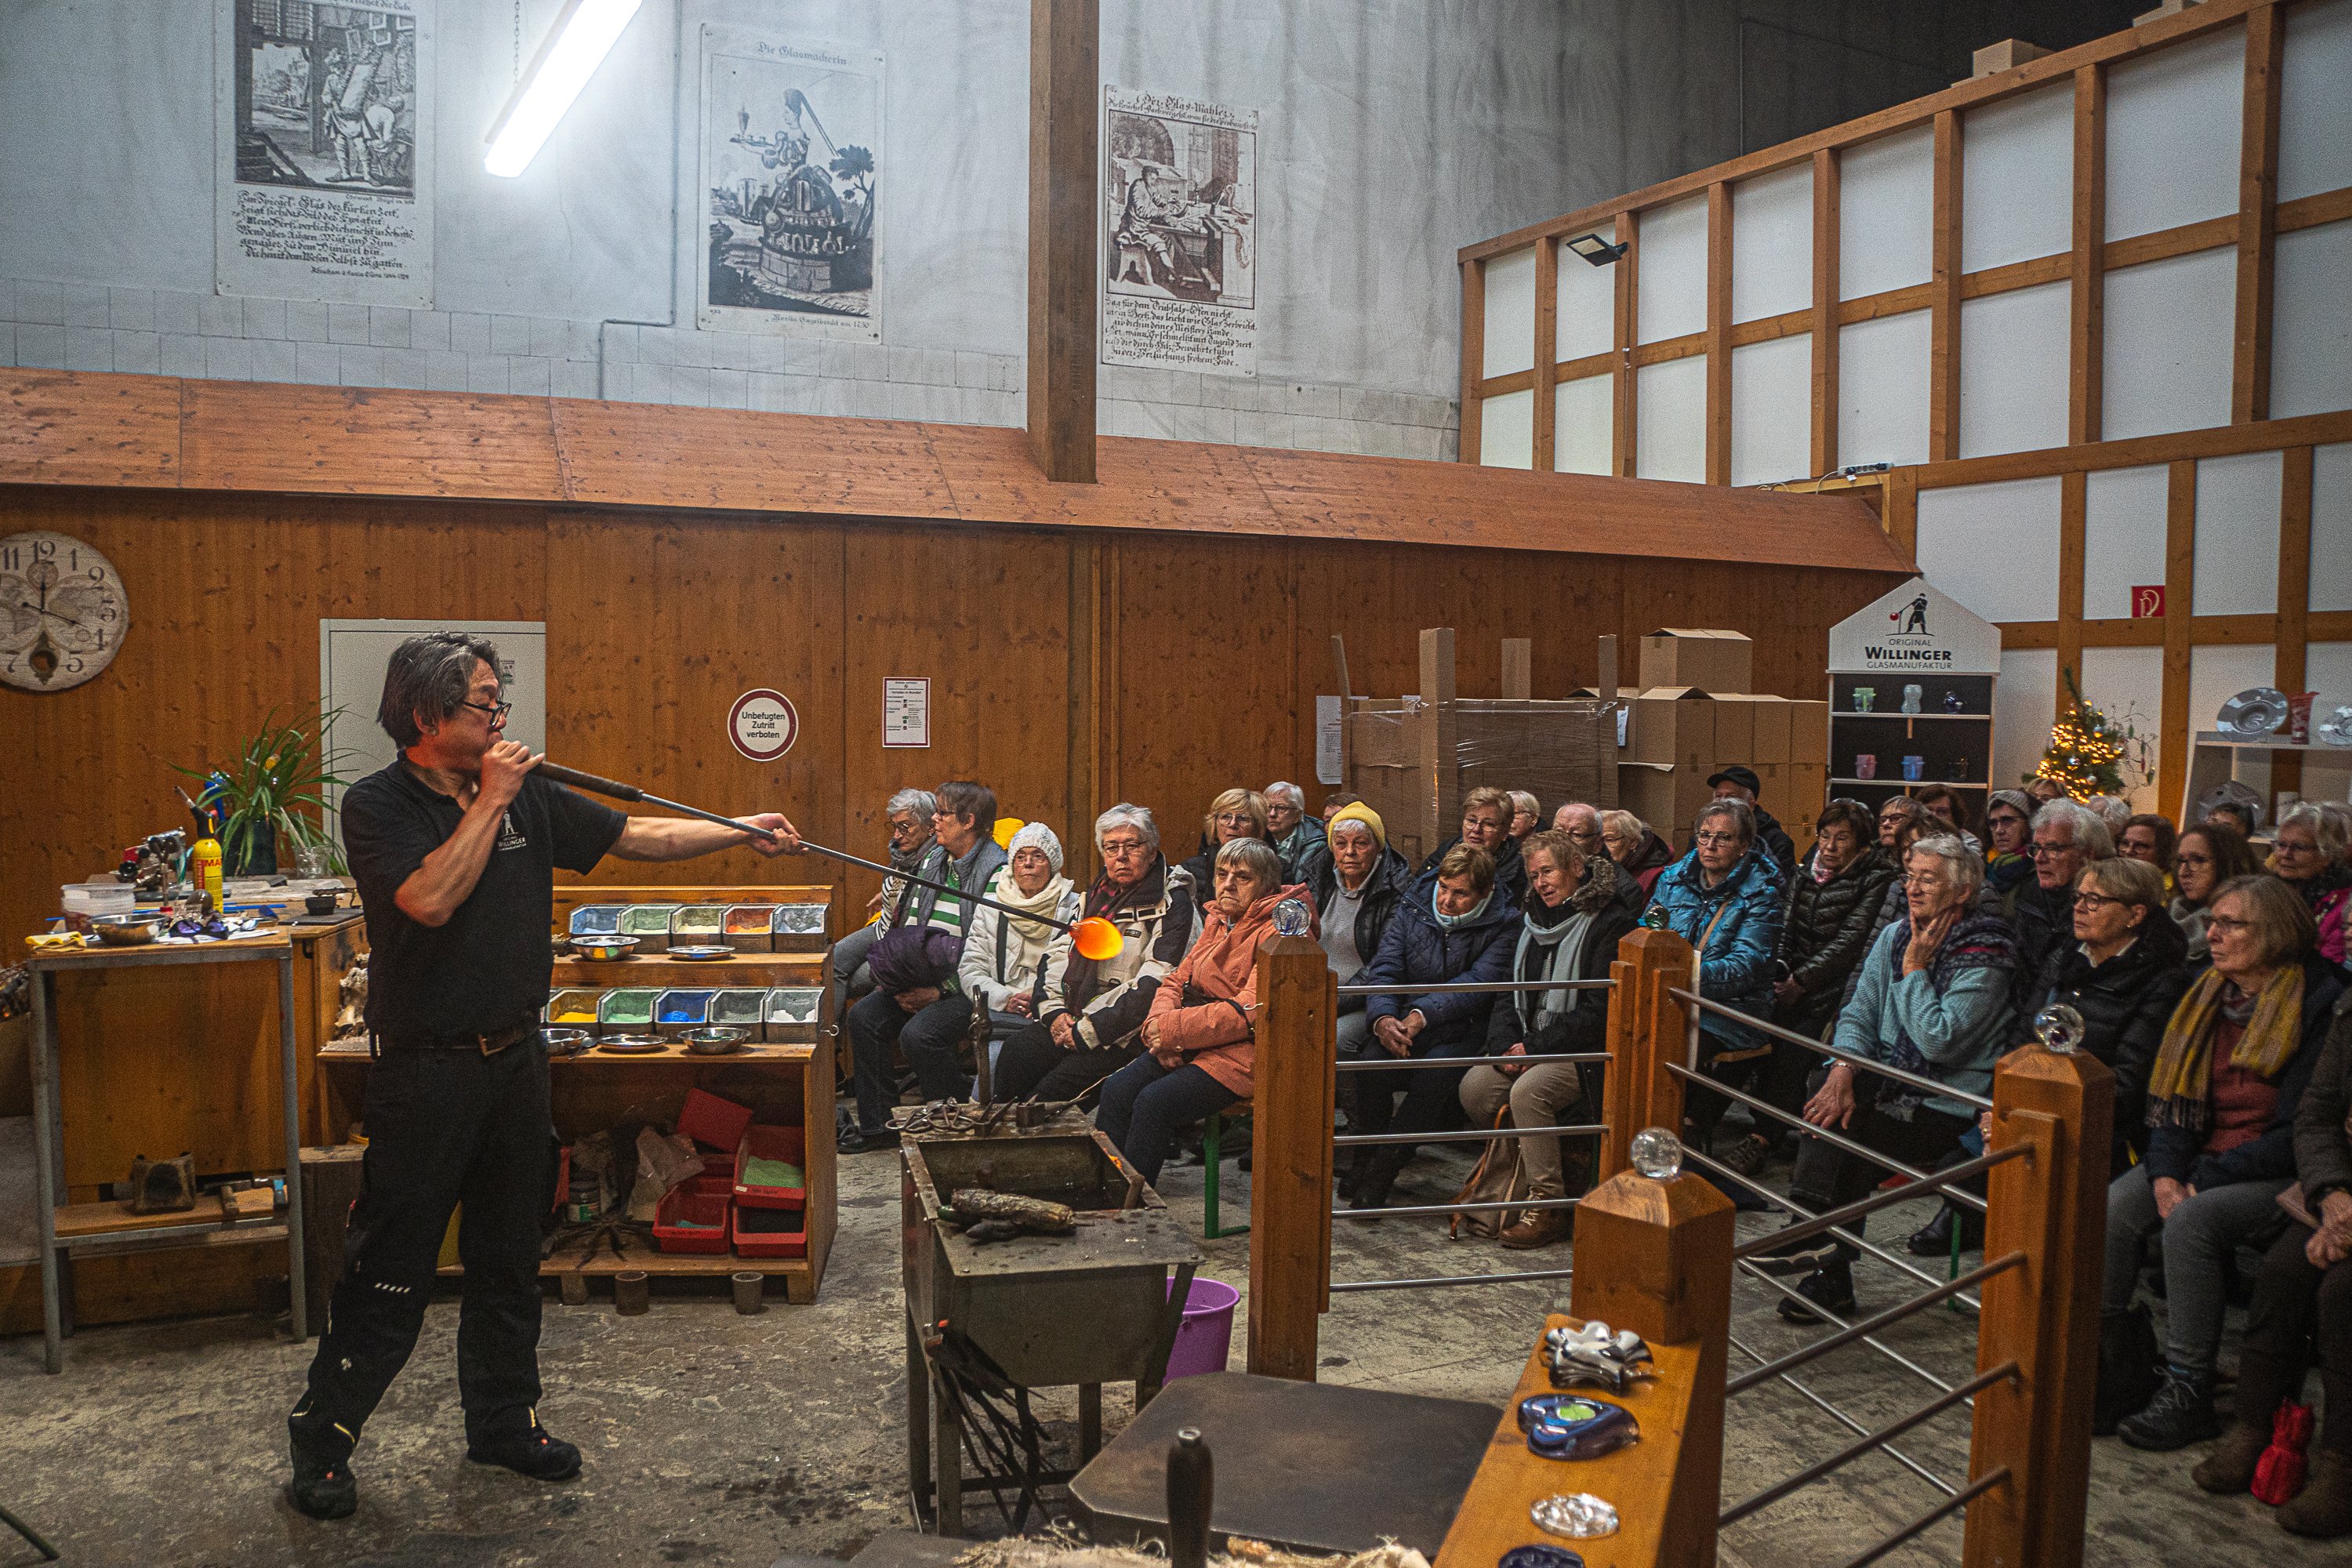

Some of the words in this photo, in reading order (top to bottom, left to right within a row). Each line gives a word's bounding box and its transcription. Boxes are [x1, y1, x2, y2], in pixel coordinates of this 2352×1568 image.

[757, 42, 775, 54] Die
[779, 45, 847, 65] Glasmacherin
[3, 546, 20, 570] 11
[32, 540, 56, 565] 12
[70, 548, 78, 571] 1
[85, 566, 105, 590] 2
[100, 599, 117, 622] 3
[5, 650, 21, 673] 7
[66, 650, 84, 673] 5
[1865, 646, 1952, 660] WILLINGER
[1867, 661, 1952, 670] GLASMANUFAKTUR
[742, 711, 785, 721] Unbefugten
[497, 837, 526, 848] WILLINGER
